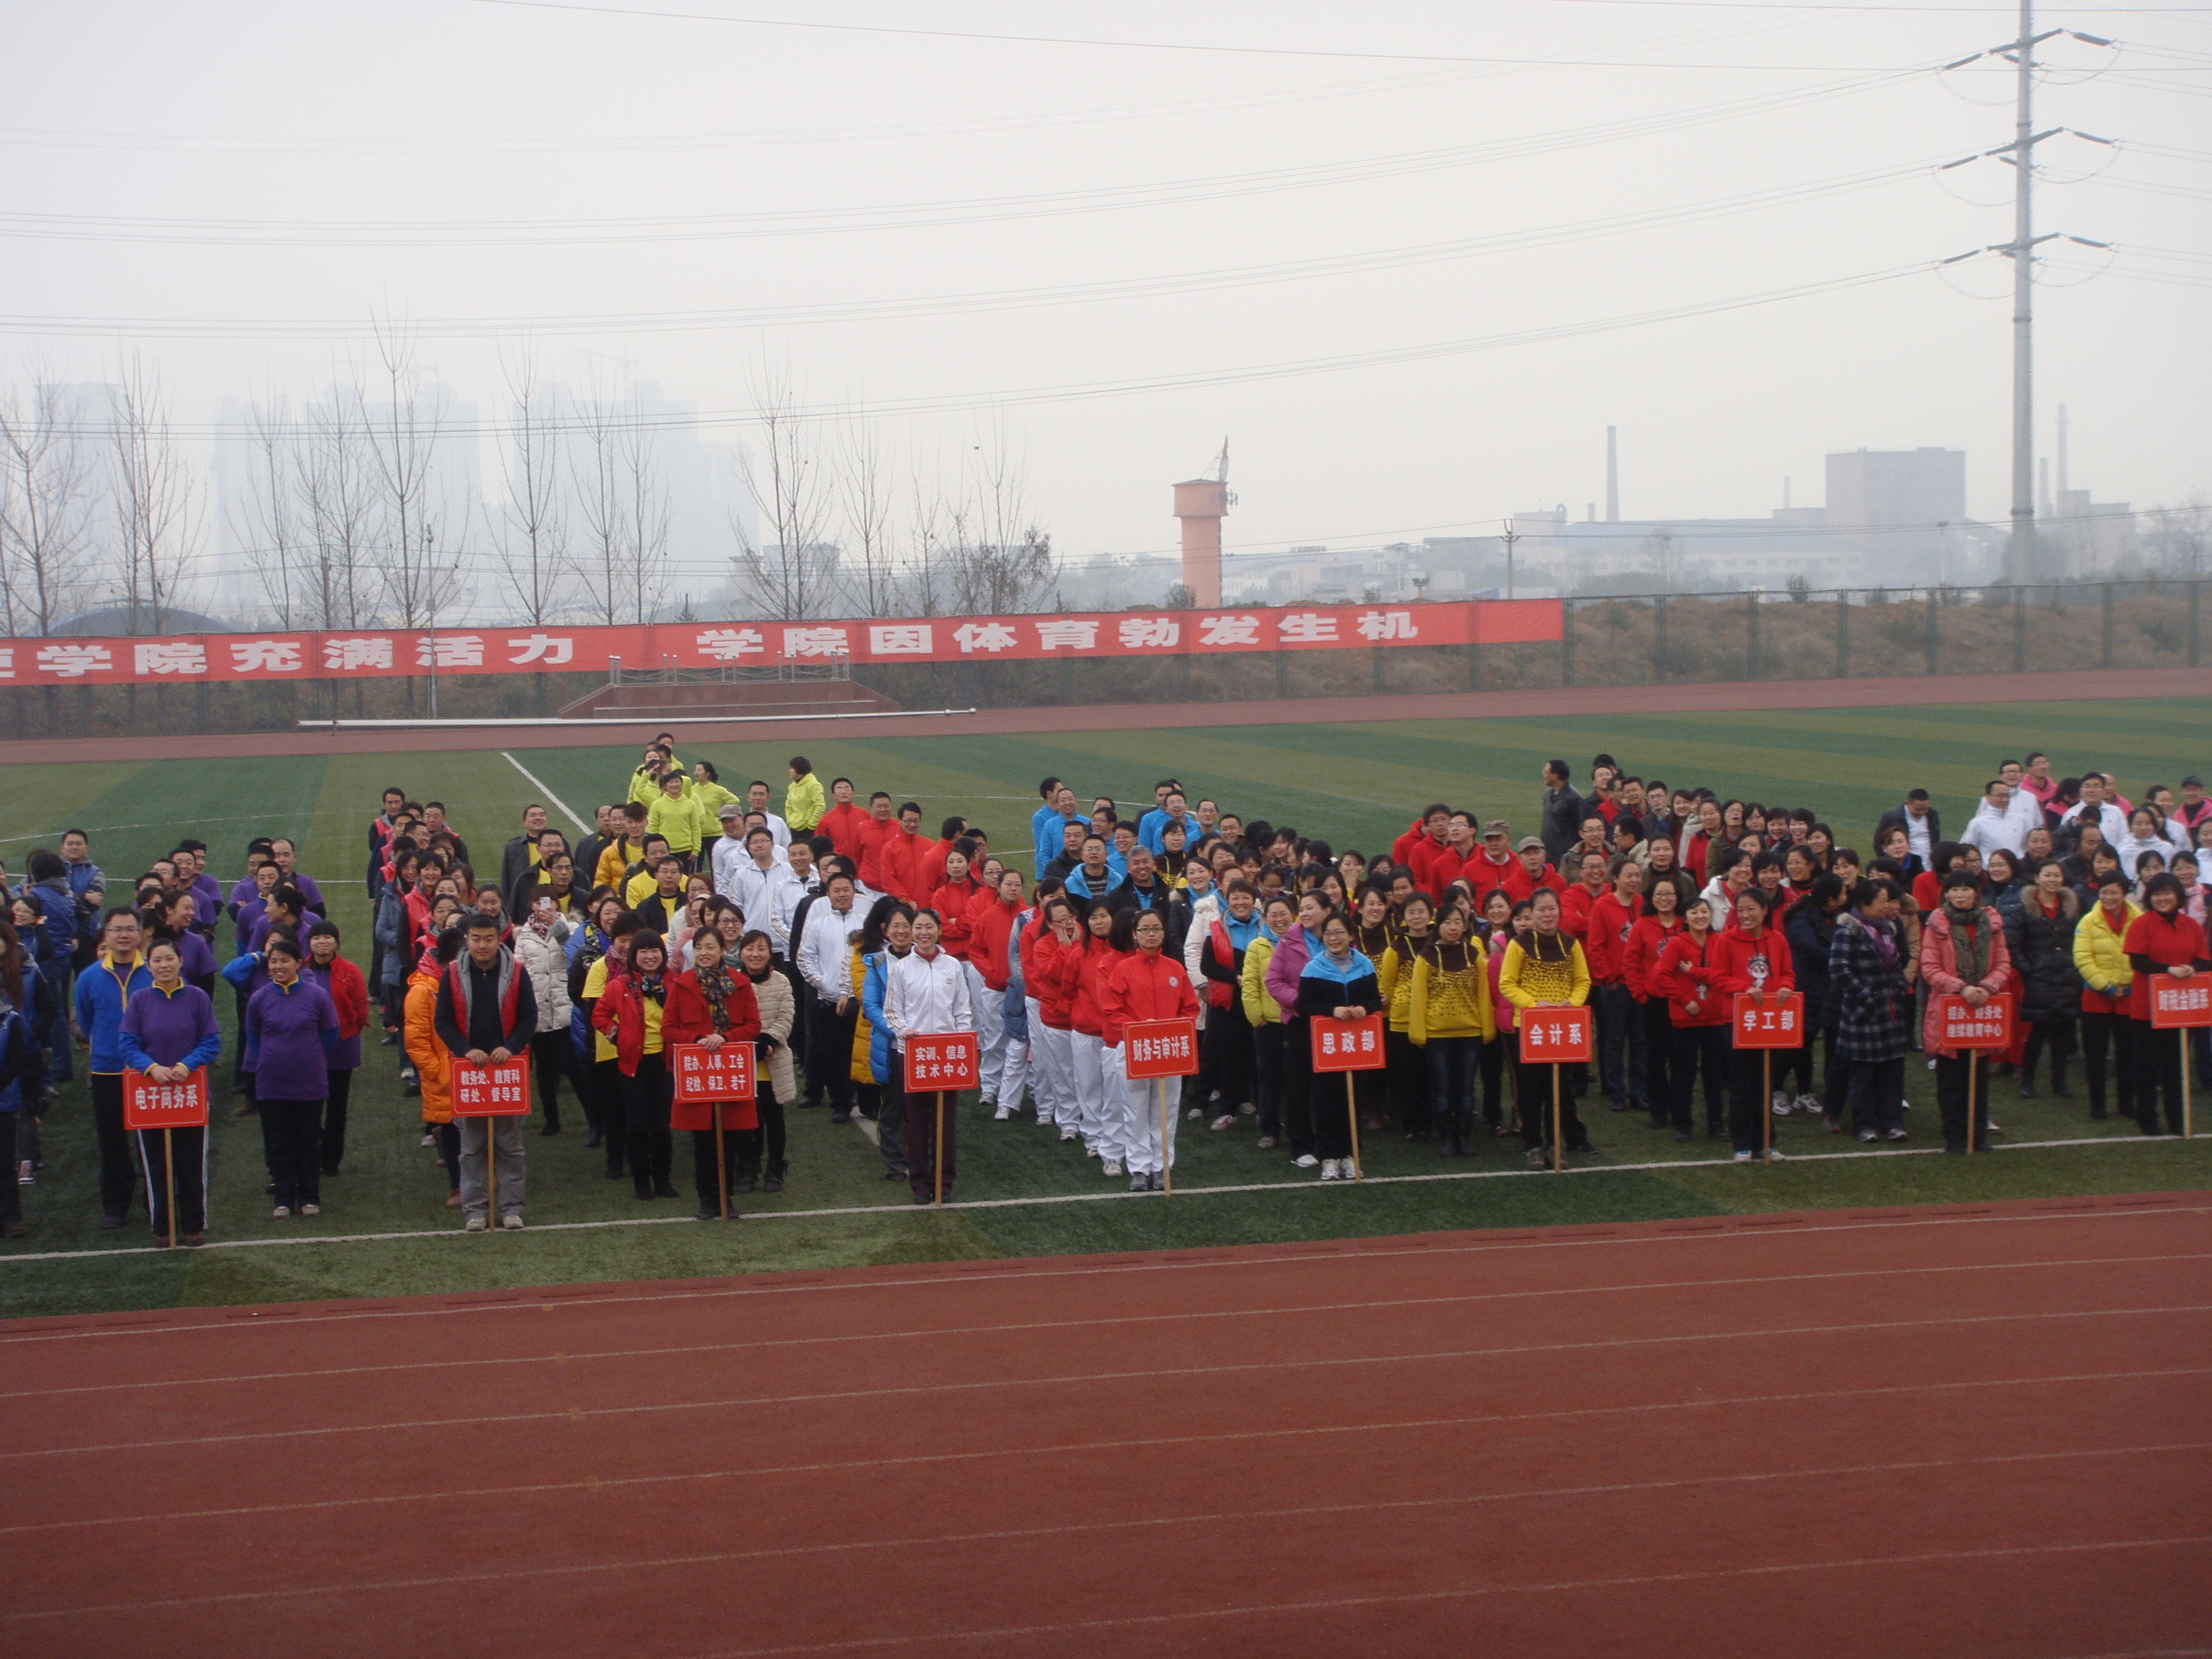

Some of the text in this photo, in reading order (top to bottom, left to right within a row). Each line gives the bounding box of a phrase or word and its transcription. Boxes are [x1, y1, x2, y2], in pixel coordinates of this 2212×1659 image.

[697, 611, 1418, 660] 学院因体育勃发生机
[0, 634, 572, 677] 学院充满活力
[1743, 1010, 1794, 1031] 学工部
[1322, 1030, 1375, 1054] 思政部
[1529, 1023, 1582, 1045] 会计系
[915, 1045, 967, 1061] 实训、信息
[1133, 1035, 1190, 1061] 财务与审计系
[460, 1069, 520, 1085] 教务处、教育科
[915, 1062, 968, 1079] 技术中心
[135, 1084, 198, 1110] 电子商务系
